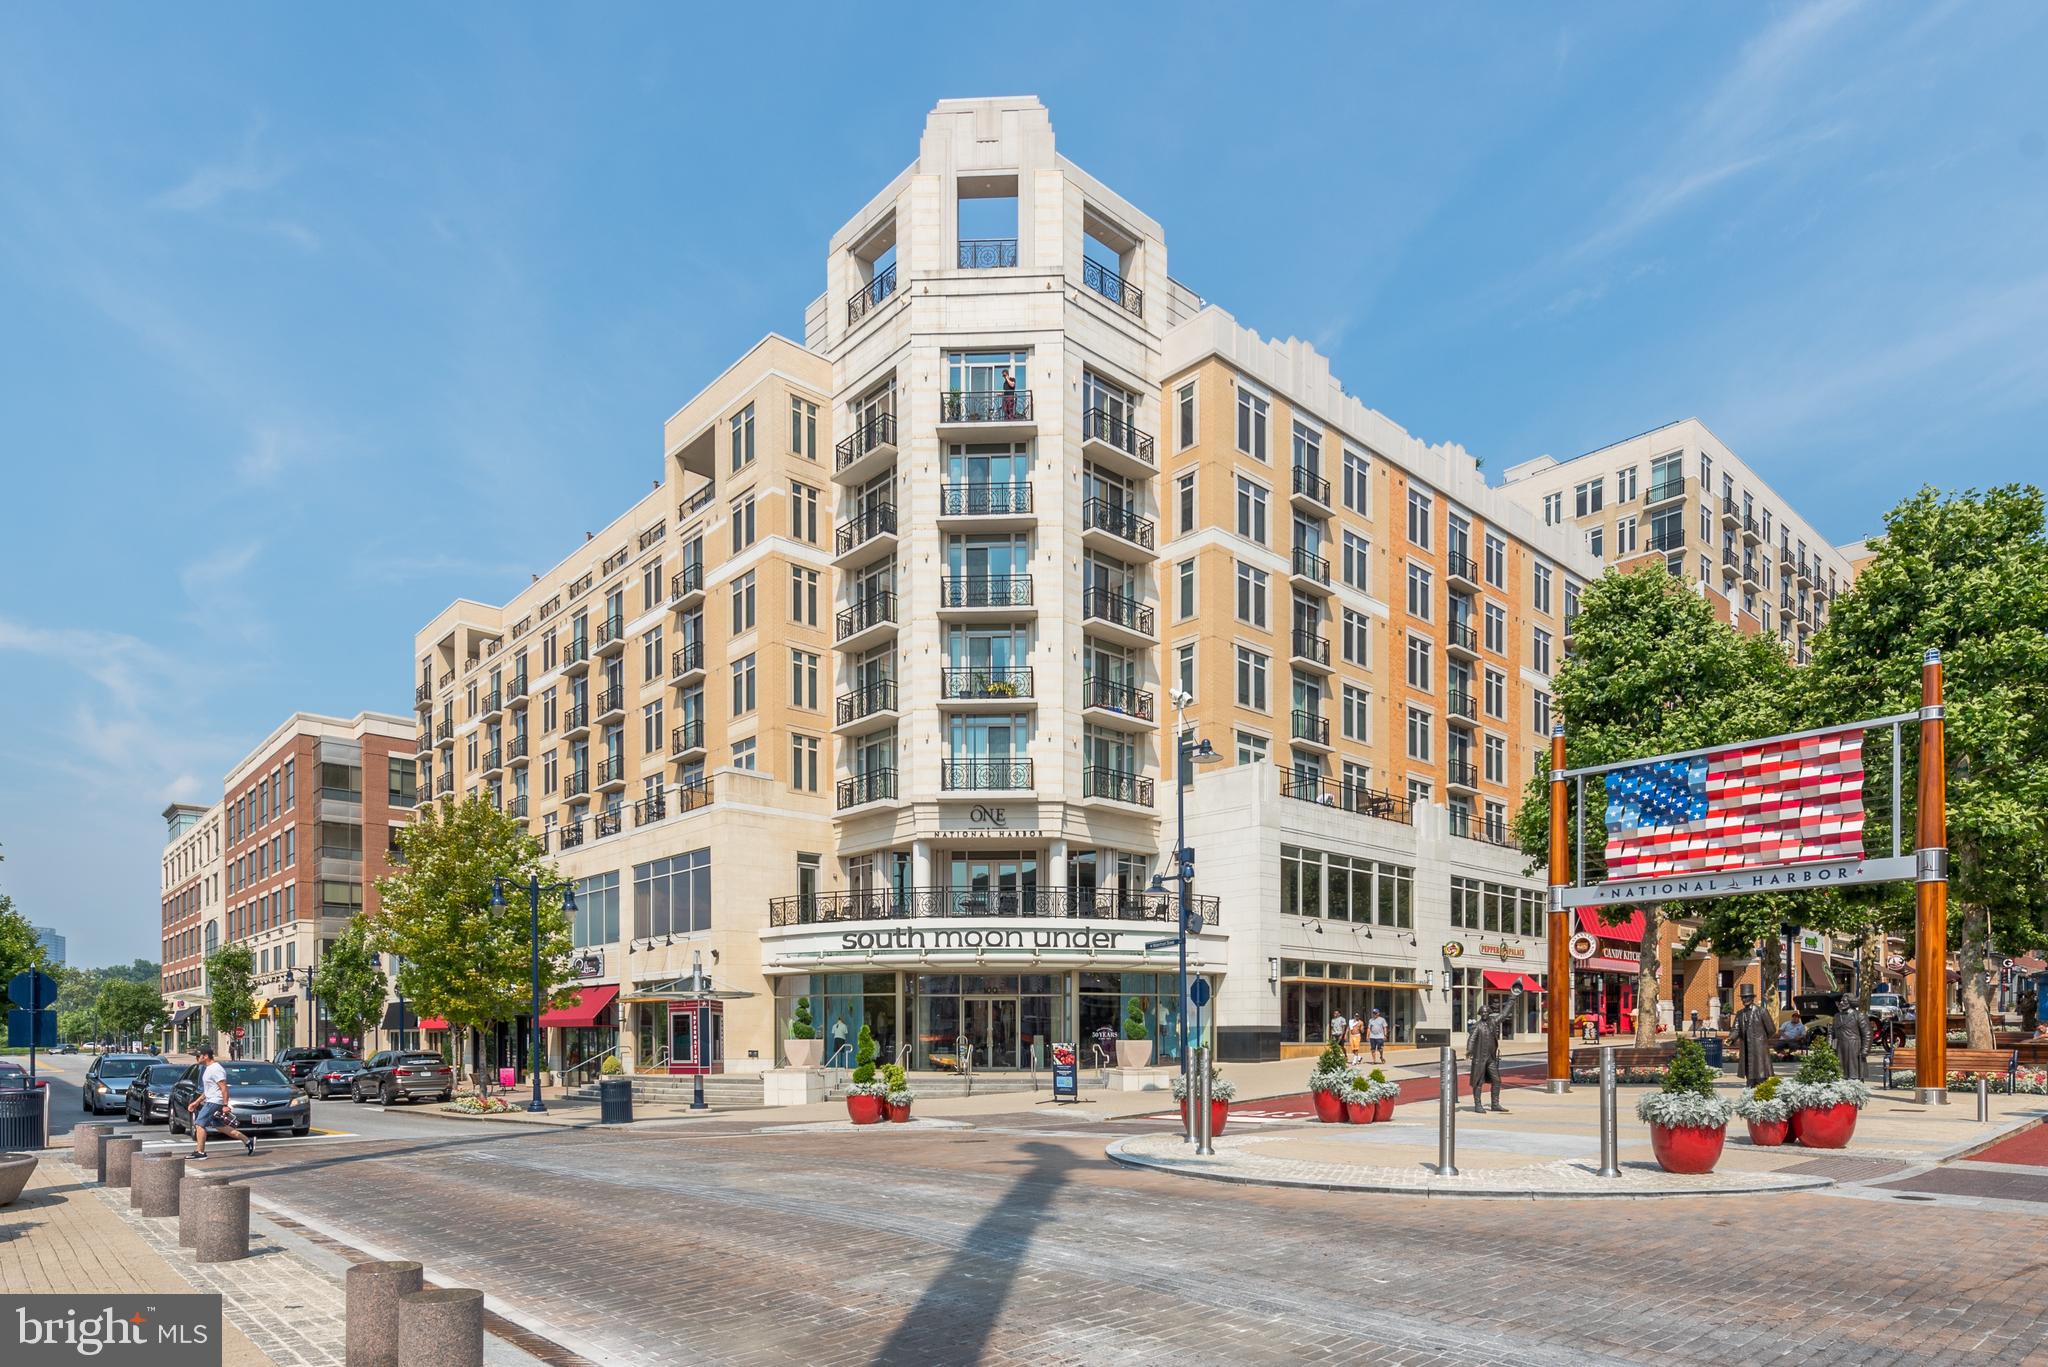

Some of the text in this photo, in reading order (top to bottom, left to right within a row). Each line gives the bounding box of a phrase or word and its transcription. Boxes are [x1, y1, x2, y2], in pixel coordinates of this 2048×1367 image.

[970, 804, 1006, 826] ONE
[1610, 867, 1848, 899] NATIONAL HARBOR
[842, 926, 1124, 950] south moon under
[1603, 948, 1623, 959] CANDY
[1623, 951, 1641, 960] KITCH
